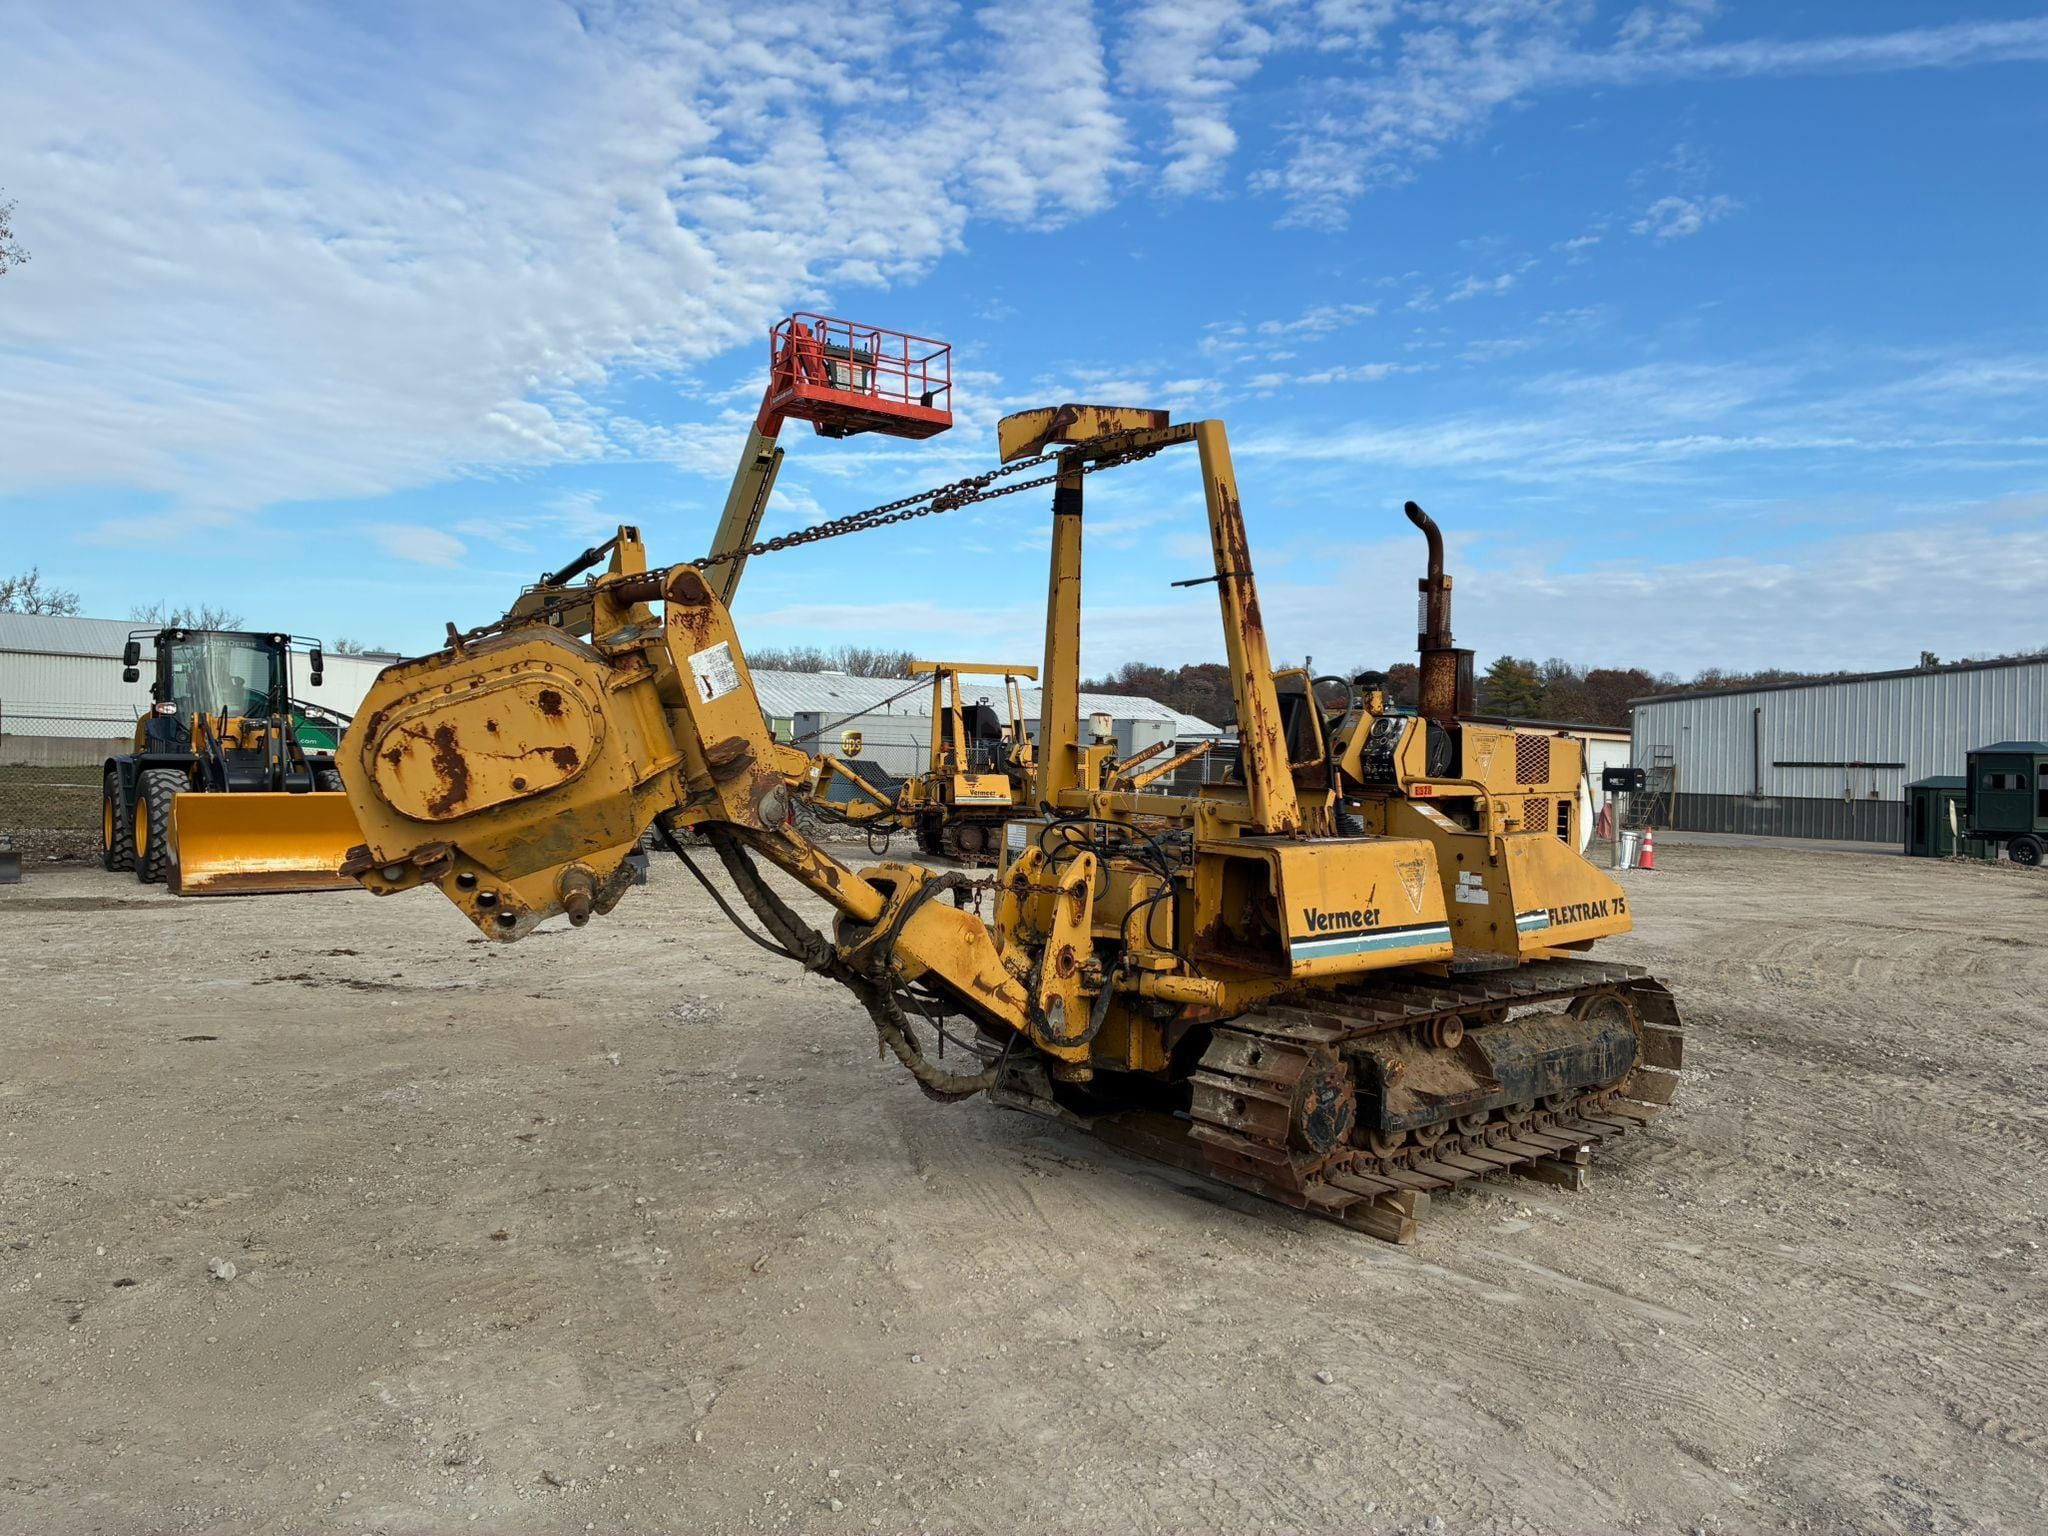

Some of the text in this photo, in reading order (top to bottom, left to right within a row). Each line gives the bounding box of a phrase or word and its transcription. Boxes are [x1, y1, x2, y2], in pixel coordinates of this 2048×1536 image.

[842, 739, 862, 755] ups
[1303, 907, 1380, 931] Vermeer
[1548, 897, 1626, 927] FLEXTRAK 75
